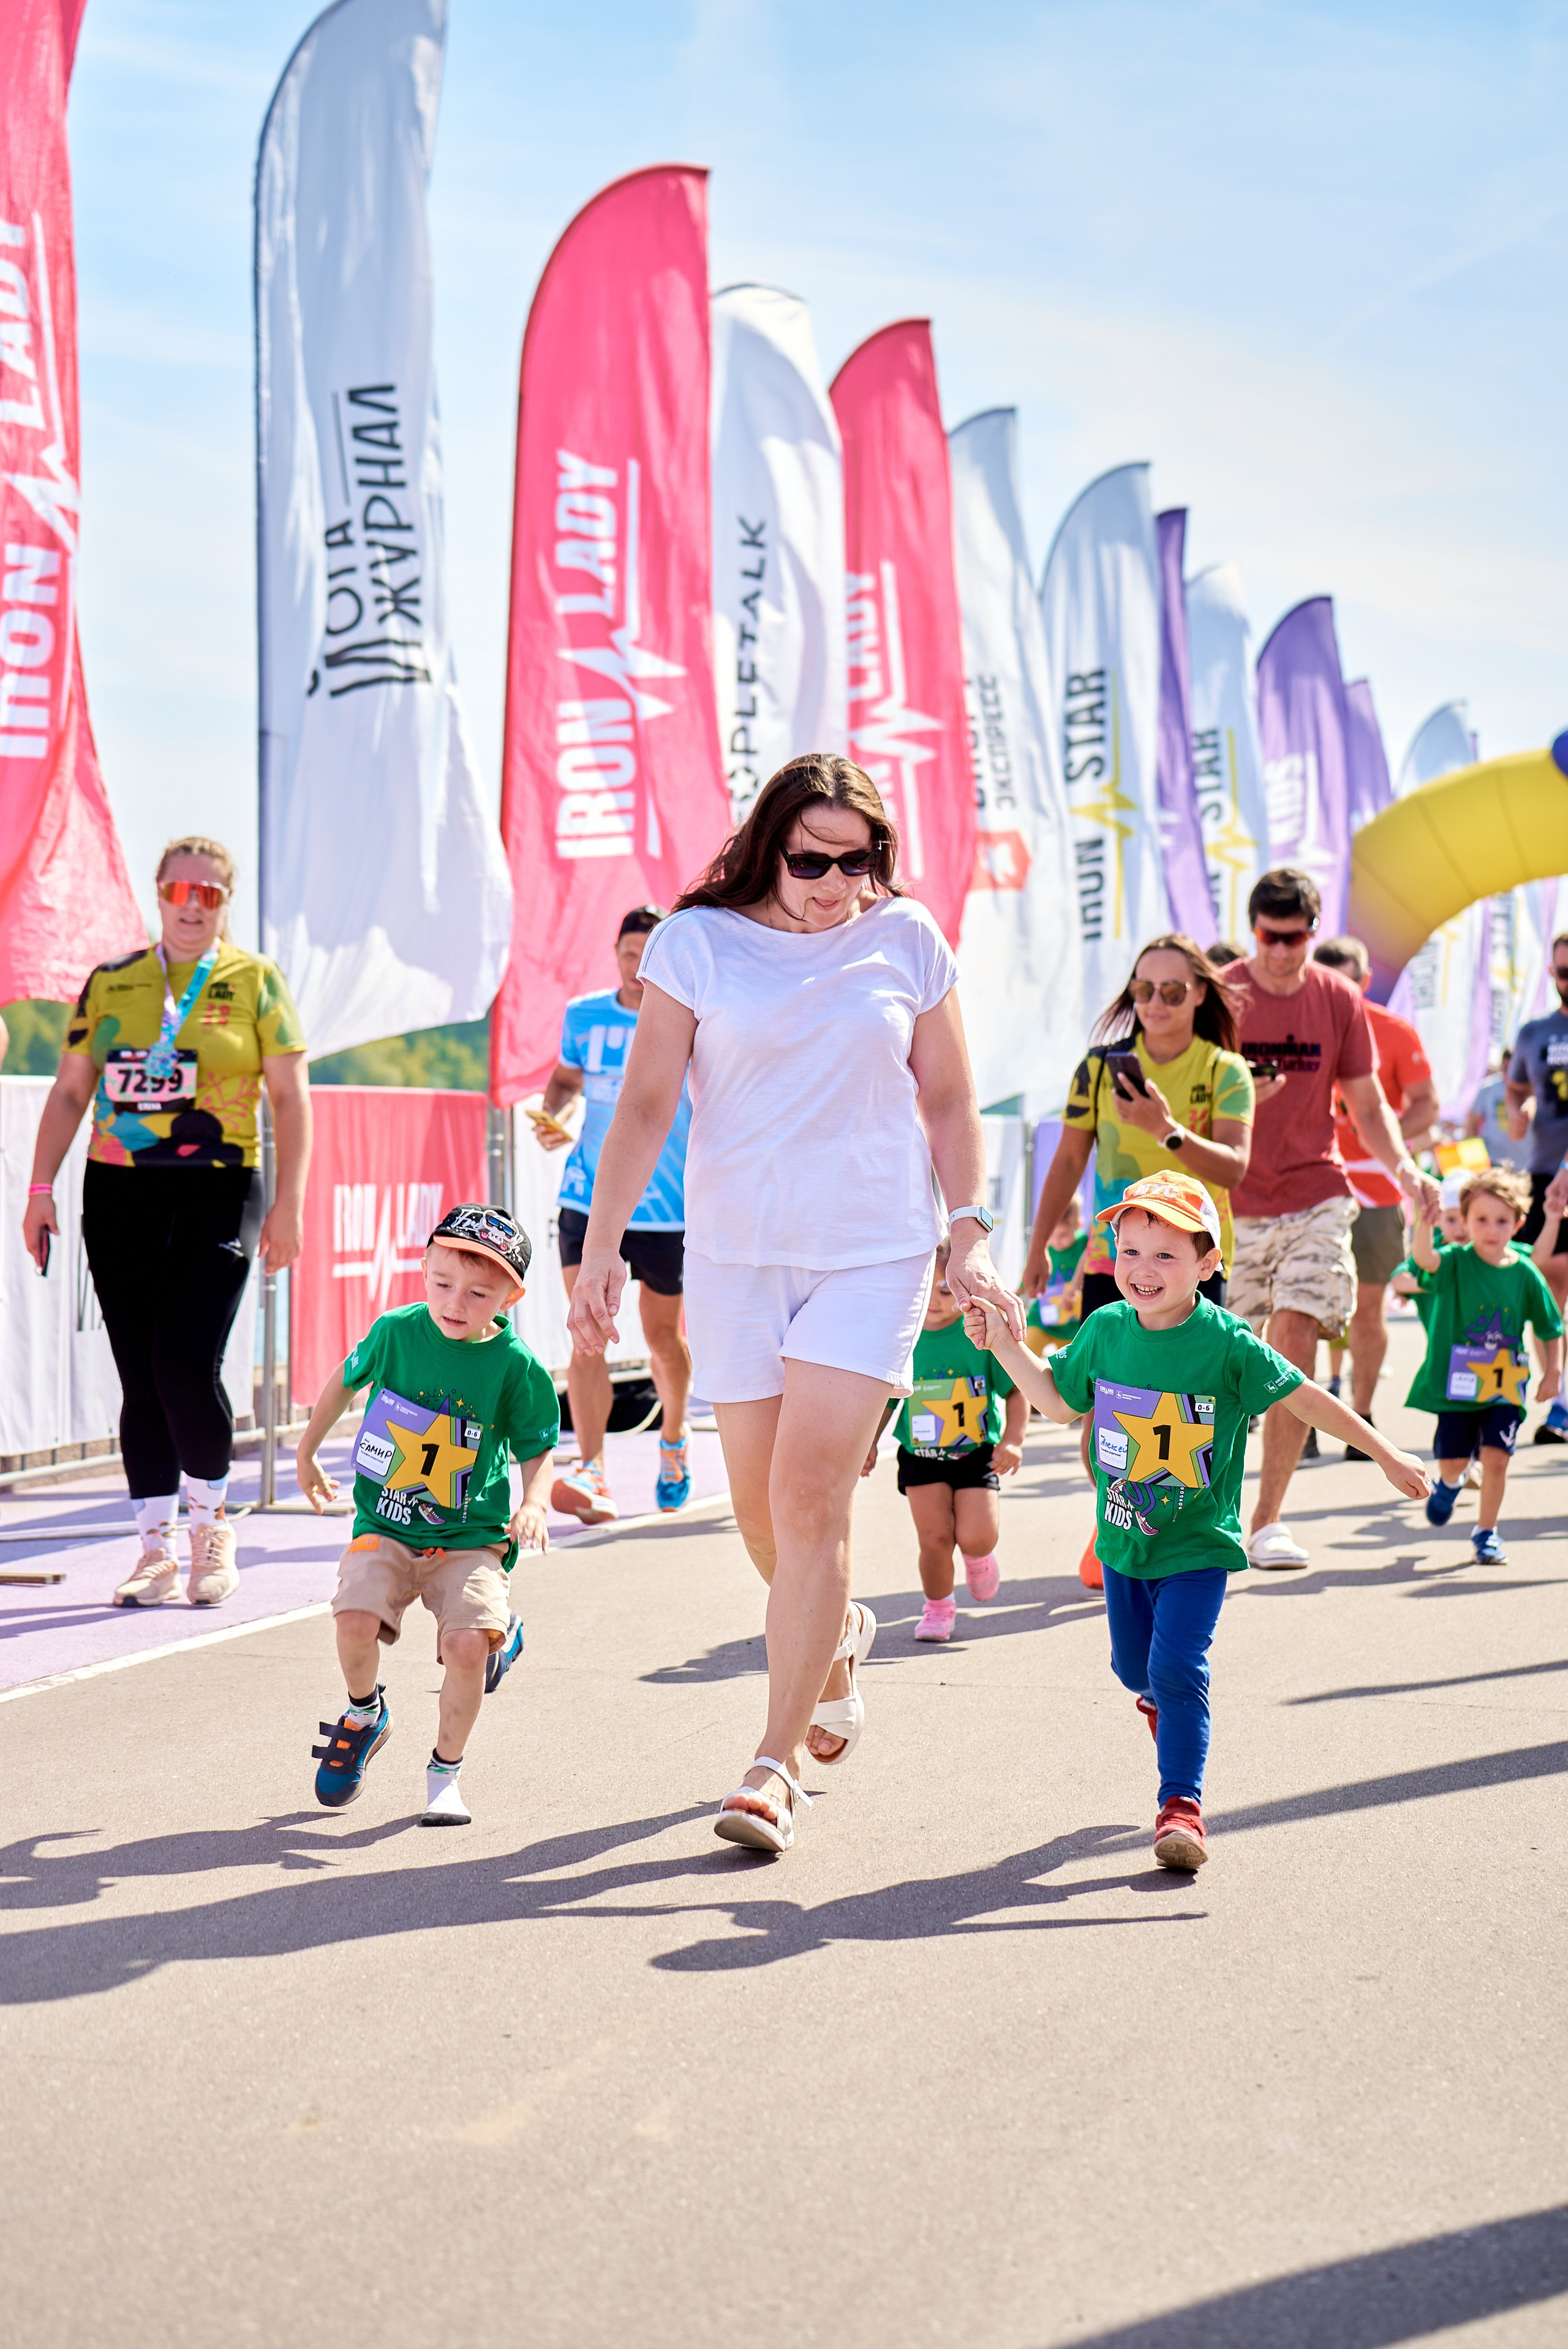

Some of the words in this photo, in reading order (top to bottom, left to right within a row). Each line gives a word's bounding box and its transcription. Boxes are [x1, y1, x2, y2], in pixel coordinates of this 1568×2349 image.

[347, 384, 422, 625] ЖУРНАЛ
[554, 449, 619, 619] LADY
[1065, 668, 1106, 783] STAR
[556, 697, 635, 859] IRON
[1133, 1183, 1178, 1199] NYC
[333, 1183, 377, 1253] IRON
[397, 1182, 444, 1250] LADY
[491, 1232, 503, 1242] yes
[1493, 1367, 1504, 1389] 1
[952, 1401, 965, 1427] 1
[360, 1442, 393, 1459] САМИР
[914, 1448, 938, 1458] STAR
[1100, 1438, 1128, 1454] Алексей
[1152, 1424, 1172, 1461] 1
[420, 1443, 440, 1477] 1
[381, 1485, 407, 1506] STAR
[1106, 1487, 1128, 1509] STAR
[375, 1496, 412, 1526] KIDS
[1104, 1501, 1133, 1531] KIDS
